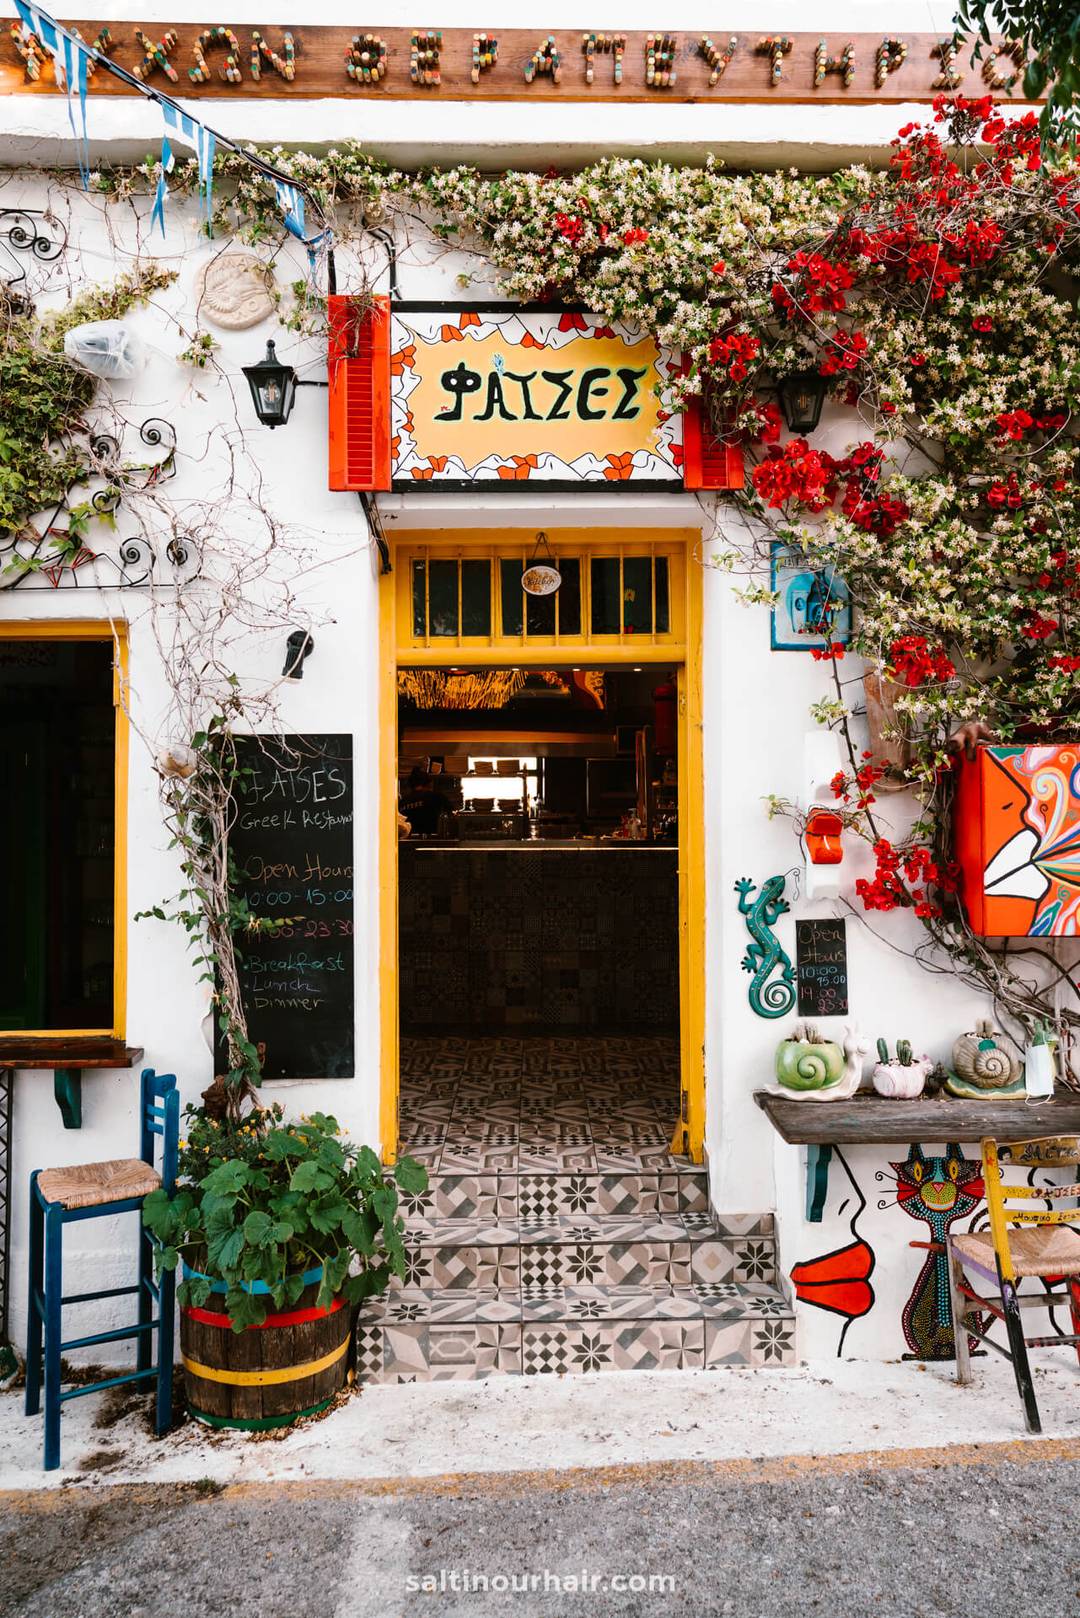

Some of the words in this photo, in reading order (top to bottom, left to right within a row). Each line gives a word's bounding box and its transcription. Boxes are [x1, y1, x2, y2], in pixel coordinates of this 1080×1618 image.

[433, 361, 648, 422] ΦΑΤΣΕΣ
[245, 855, 299, 885] Open
[799, 922, 844, 945] Open
[249, 952, 345, 974] Breakfast
[801, 966, 838, 979] 10:00
[252, 976, 321, 993] Lunch
[254, 997, 325, 1011] Dinner
